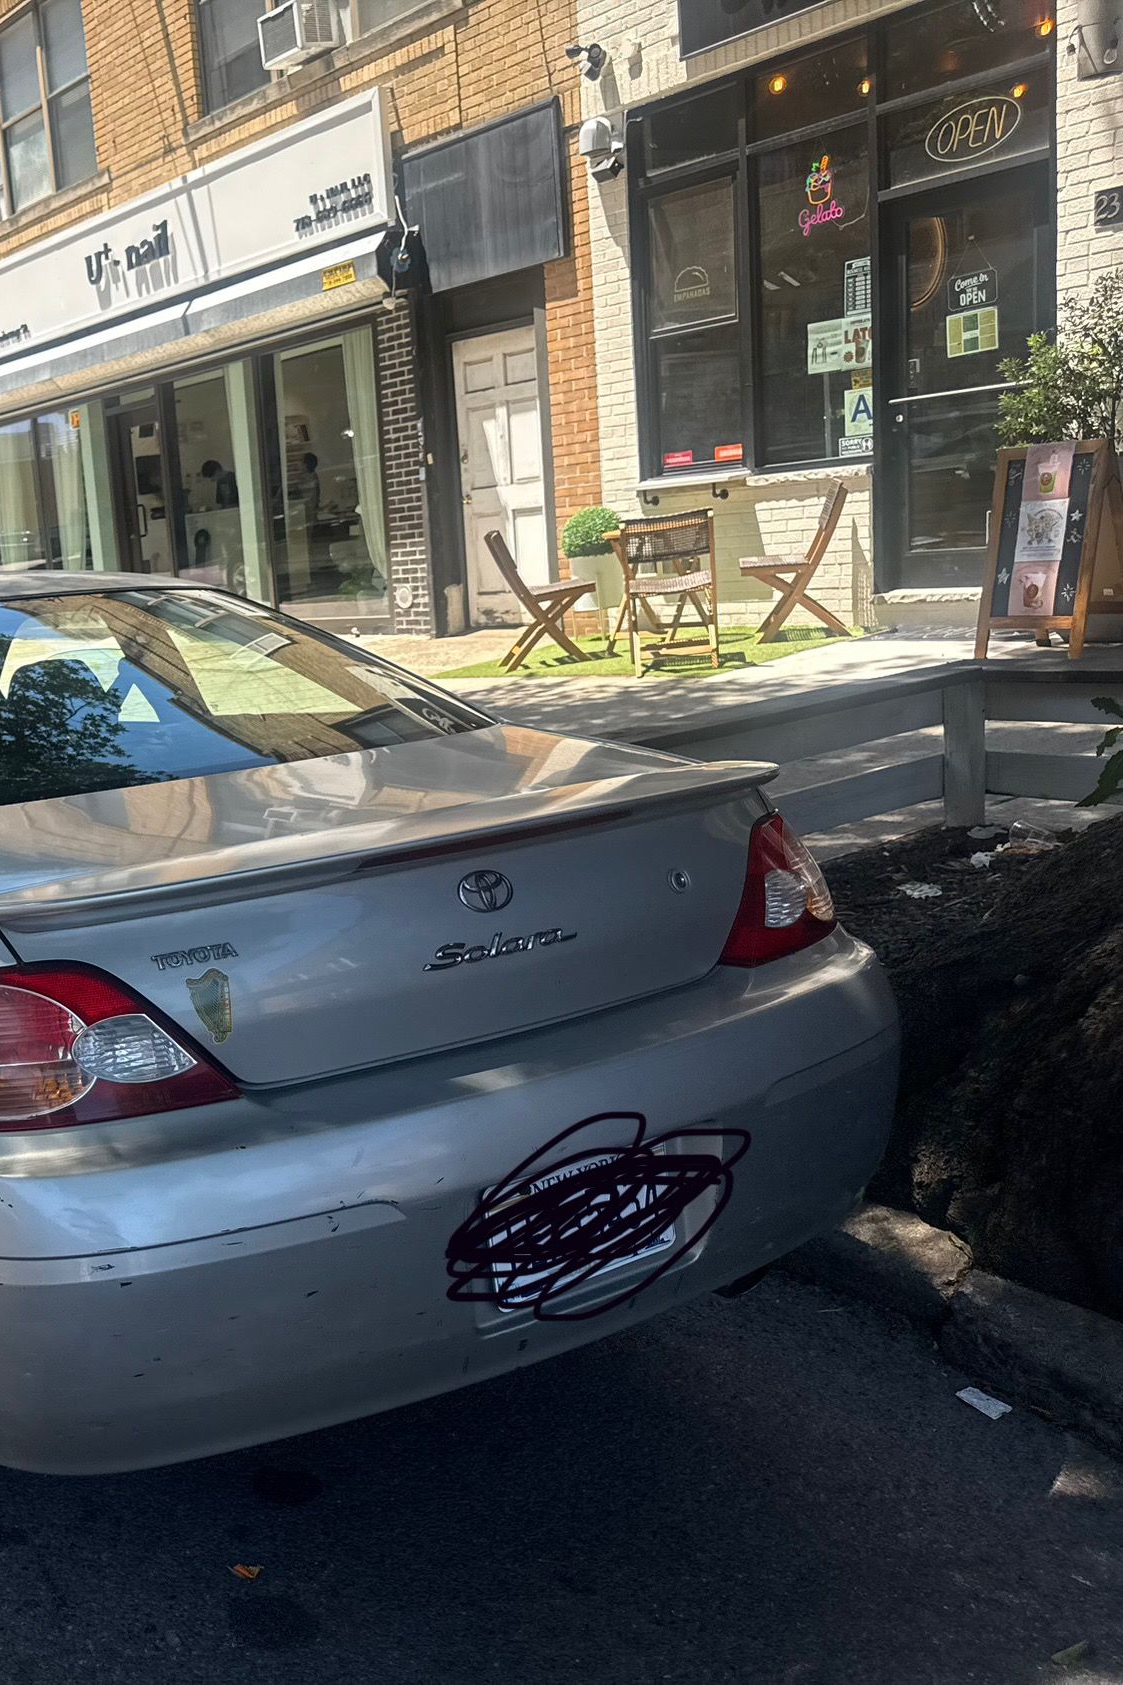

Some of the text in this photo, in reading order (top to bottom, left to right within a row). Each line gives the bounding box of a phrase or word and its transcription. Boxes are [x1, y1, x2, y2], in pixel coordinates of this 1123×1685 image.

[937, 104, 1007, 155] OPEN
[798, 200, 845, 236] Gelato
[1095, 193, 1120, 220] 23
[124, 219, 170, 272] nail
[674, 287, 710, 302] EMPANADAS
[954, 276, 979, 292] Come
[959, 289, 986, 306] OPEN
[851, 394, 873, 423] A
[841, 438, 863, 447] SORRY
[151, 942, 239, 970] TOYOTA
[423, 928, 578, 971] Solara
